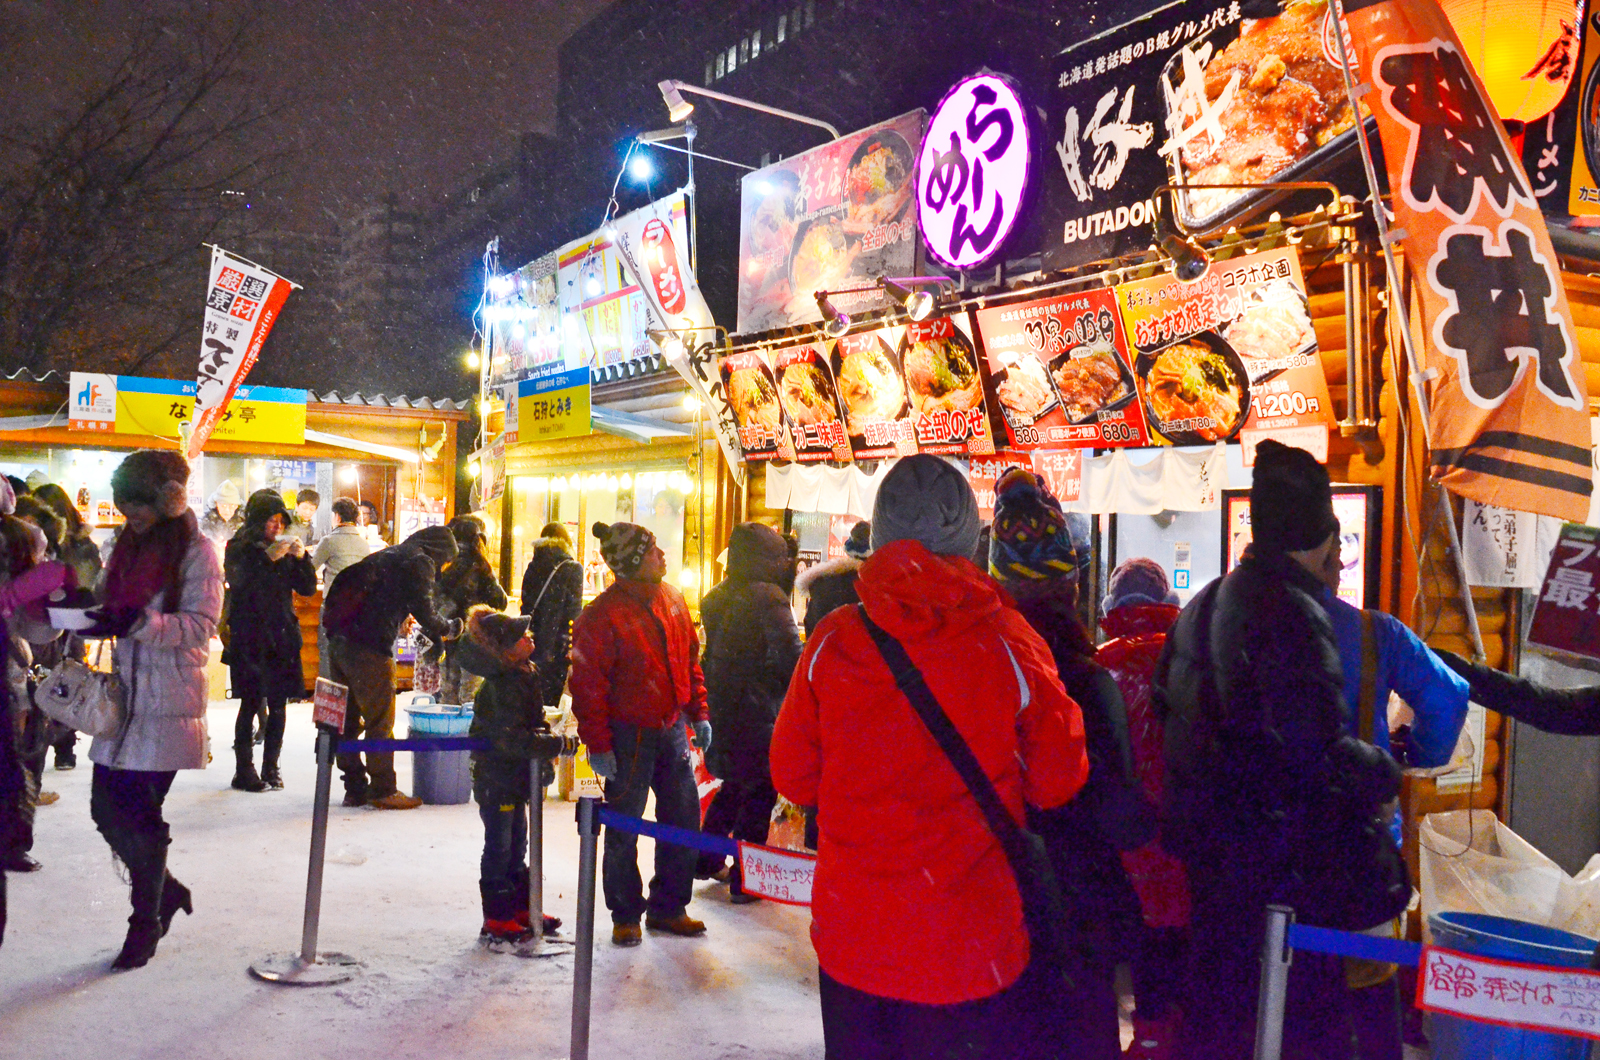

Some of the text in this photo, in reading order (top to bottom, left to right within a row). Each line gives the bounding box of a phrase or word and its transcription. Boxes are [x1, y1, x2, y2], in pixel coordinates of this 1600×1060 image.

[1058, 1, 1241, 88] 北海道発話題のB級グルメ代表
[1056, 41, 1241, 201] 豚丼
[1064, 197, 1162, 243] BUTADON
[861, 221, 913, 252] 全部のせ
[645, 220, 681, 310] ラーメン
[1222, 258, 1292, 288] コラボ企画
[1000, 298, 1090, 322] 北海道発話題のB級グルメ代表
[1134, 288, 1249, 346] おすすめ限定セット
[842, 335, 874, 352] ラーメン
[911, 321, 947, 341] ラーメン
[728, 354, 754, 371] ラーメン
[783, 348, 811, 366] ラーメン
[1286, 354, 1316, 369] 580円
[533, 397, 571, 421] 石狩とみき
[1252, 392, 1320, 418] 1,200円
[738, 424, 788, 450] 味噌ラーメン
[791, 419, 847, 449] カニ味噌
[864, 418, 914, 446] 焼豚味噌
[916, 409, 987, 443] 全部のせ
[1014, 427, 1047, 444] 580円
[1102, 423, 1140, 441] 680円
[1159, 417, 1217, 432] カニ味噌 780円
[968, 440, 992, 453] 880円
[1043, 453, 1075, 471] ご注文
[1543, 567, 1600, 611] 最
